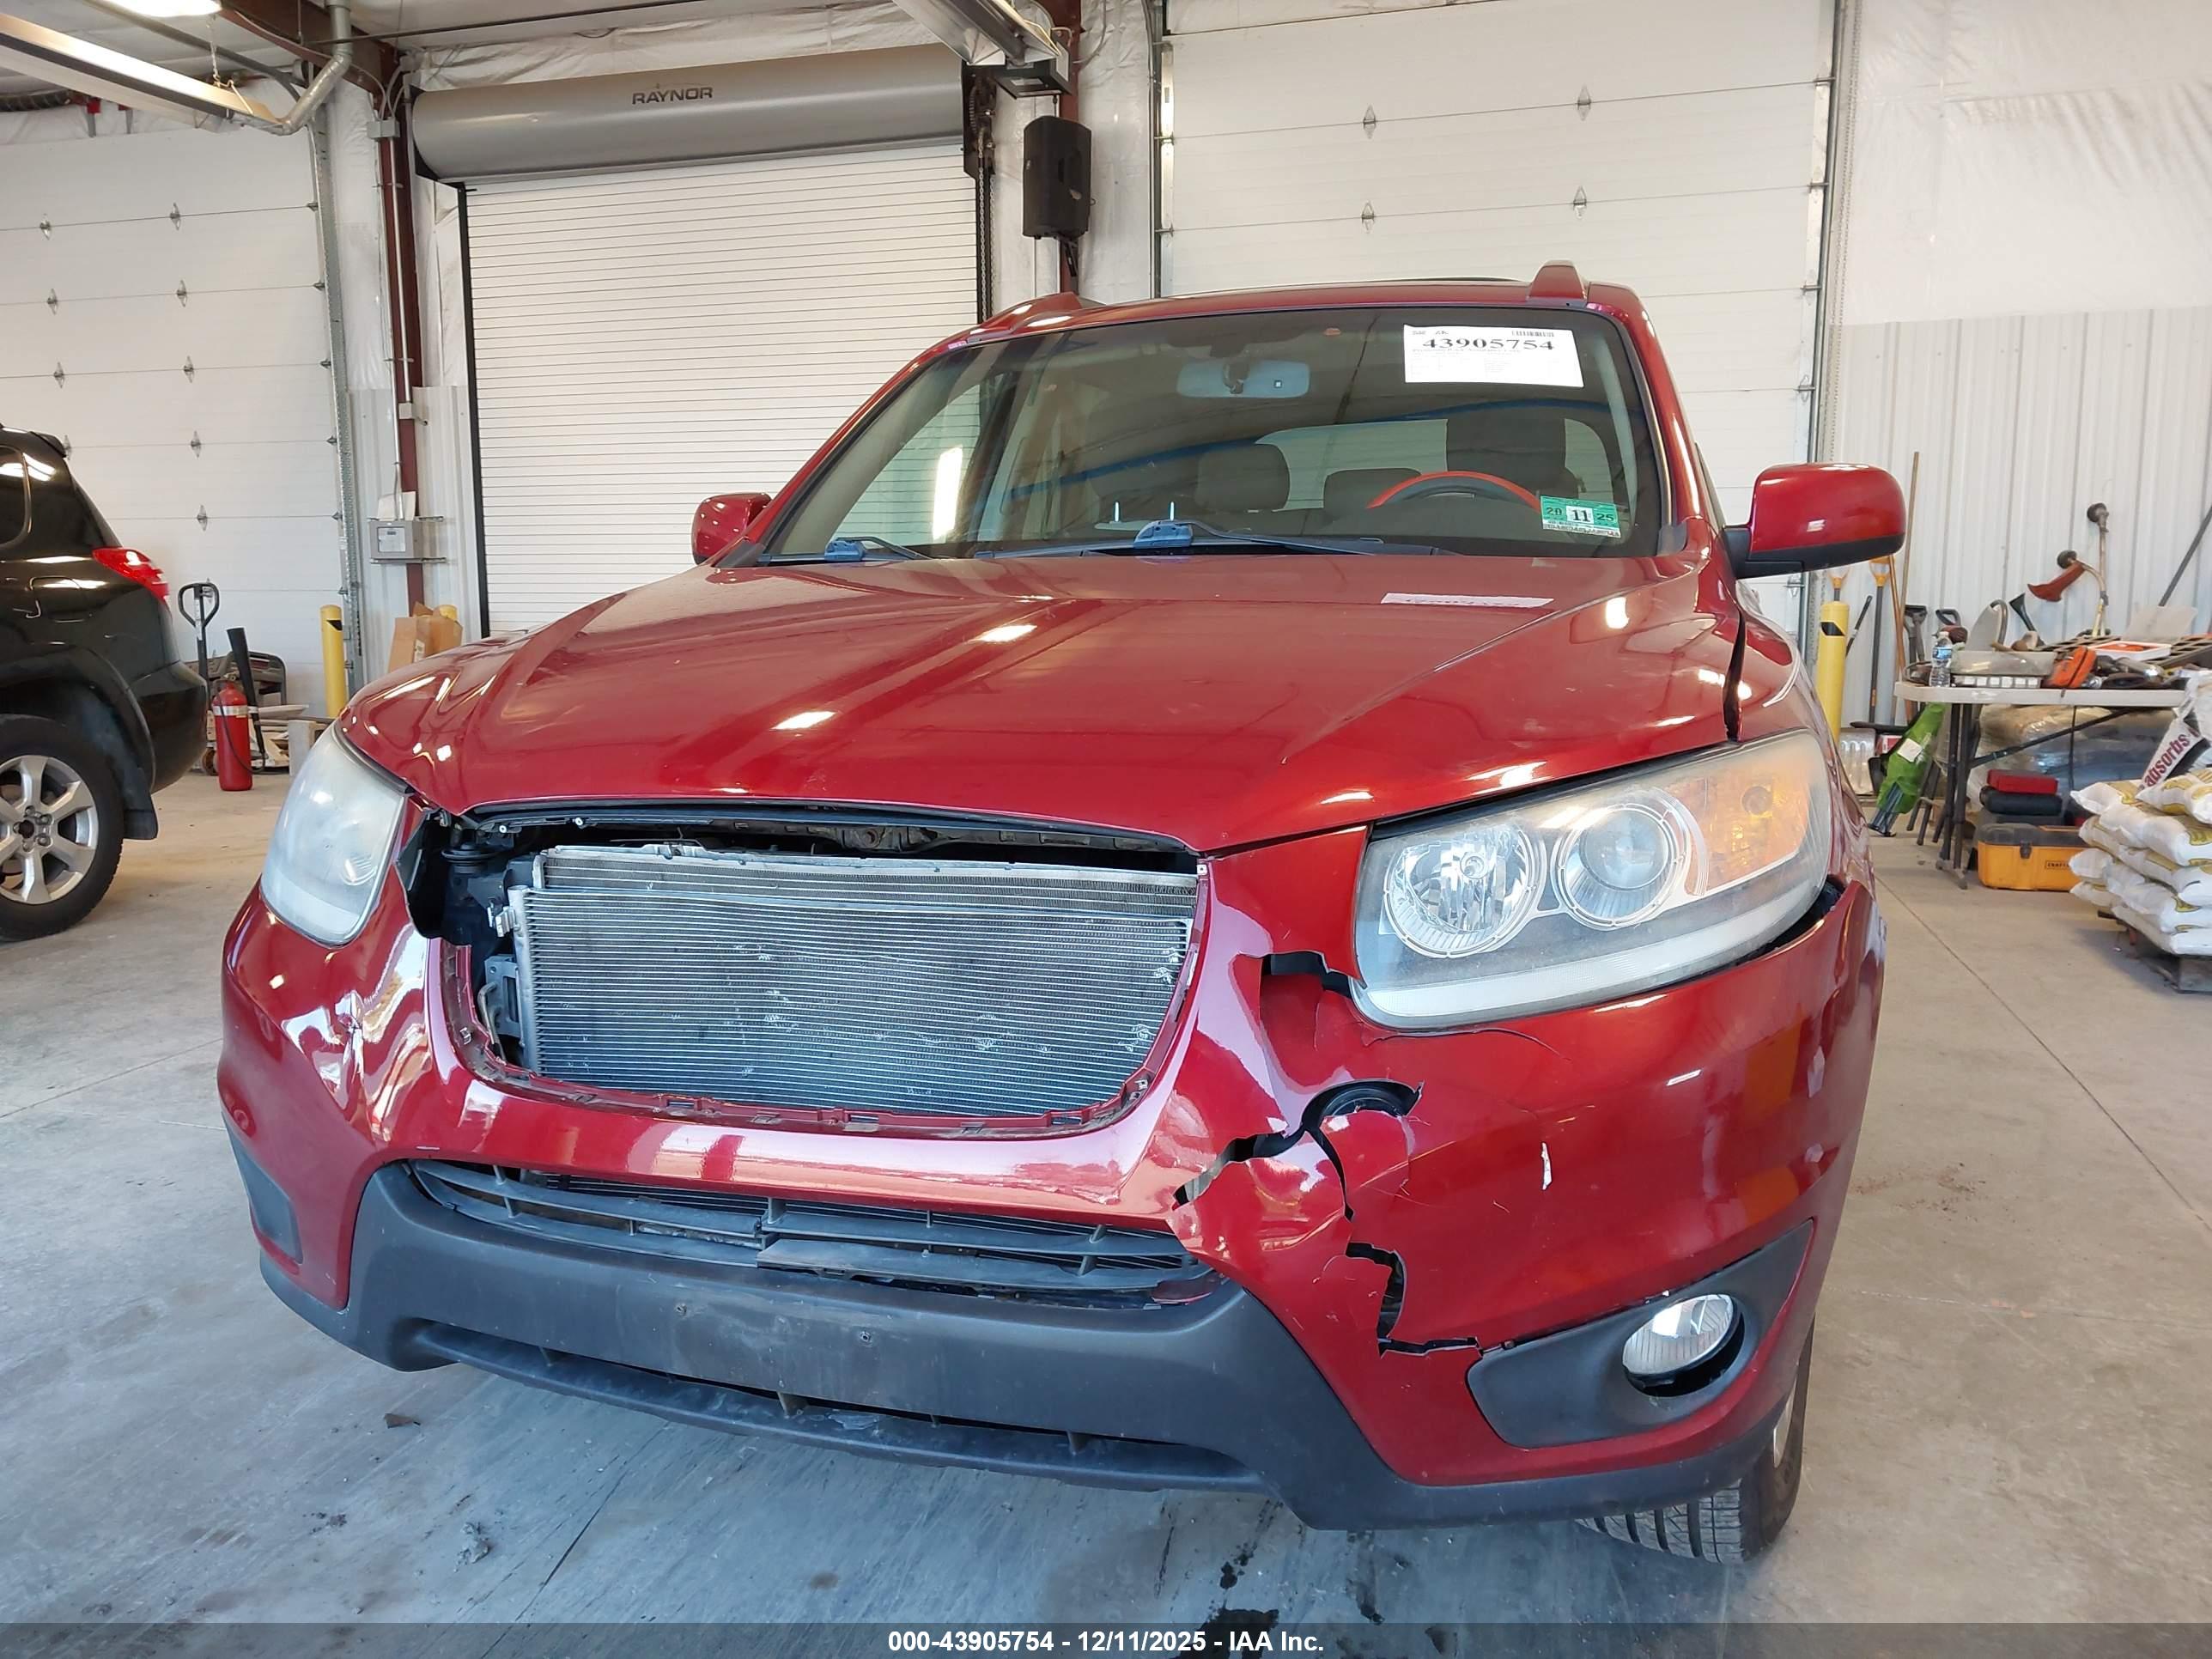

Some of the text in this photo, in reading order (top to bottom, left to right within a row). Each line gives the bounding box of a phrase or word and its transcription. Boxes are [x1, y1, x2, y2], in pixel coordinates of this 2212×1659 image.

[632, 87, 713, 105] RAYNOR
[1422, 337, 1554, 350] 43905754
[1572, 509, 1590, 522] 11
[1596, 513, 1614, 522] 25
